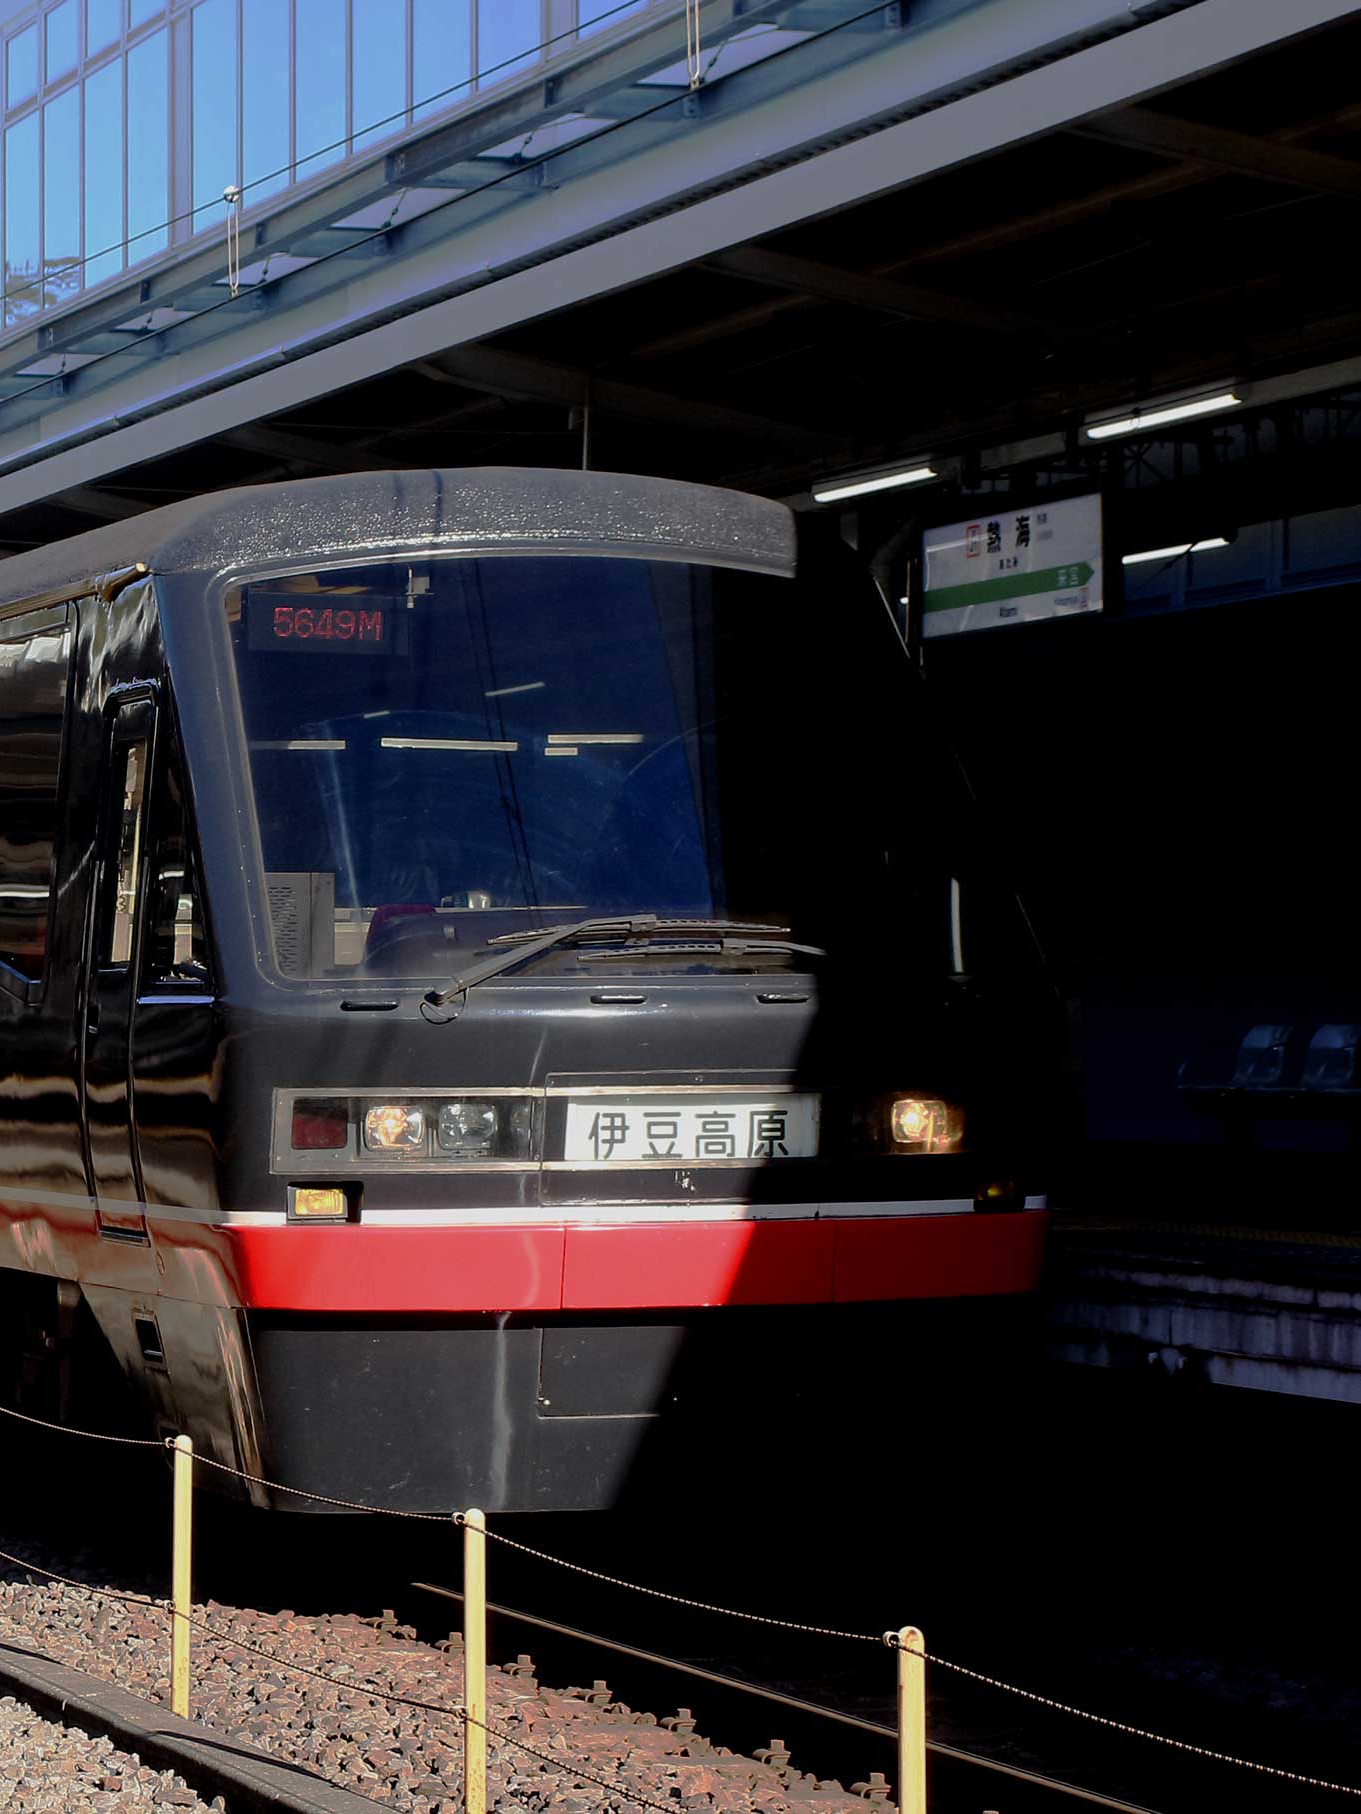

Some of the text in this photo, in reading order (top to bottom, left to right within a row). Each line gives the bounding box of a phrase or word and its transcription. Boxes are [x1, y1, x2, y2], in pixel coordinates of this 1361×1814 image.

[987, 515, 1030, 553] 熱海
[273, 607, 382, 640] 5649M
[588, 1111, 789, 1159] 伊豆高原
